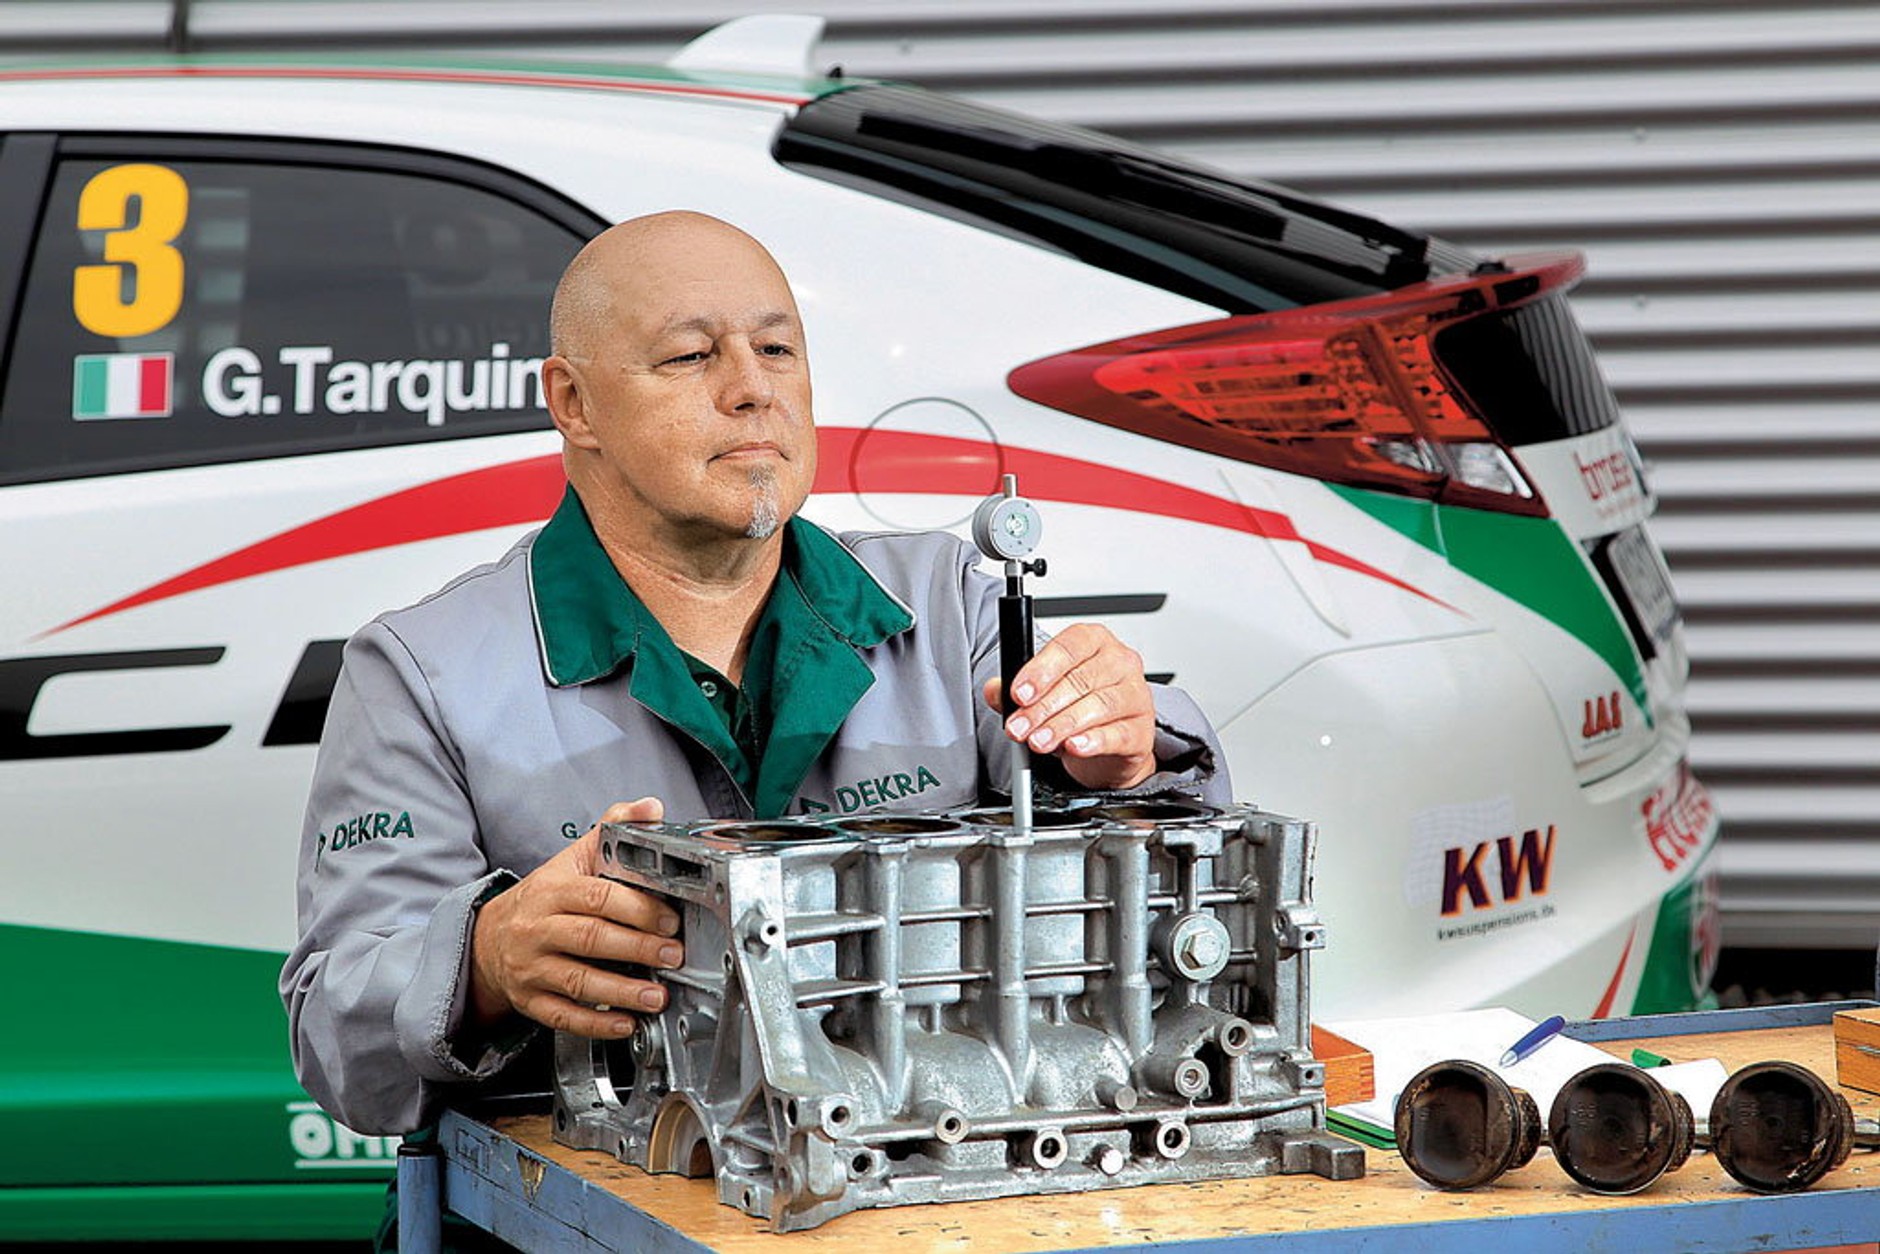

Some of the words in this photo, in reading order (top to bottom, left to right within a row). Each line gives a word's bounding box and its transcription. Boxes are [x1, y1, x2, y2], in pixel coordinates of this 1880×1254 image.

[73, 163, 190, 338] 3
[834, 765, 942, 814] DEKRA
[330, 810, 415, 851] DEKRA
[1440, 824, 1558, 917] KW
